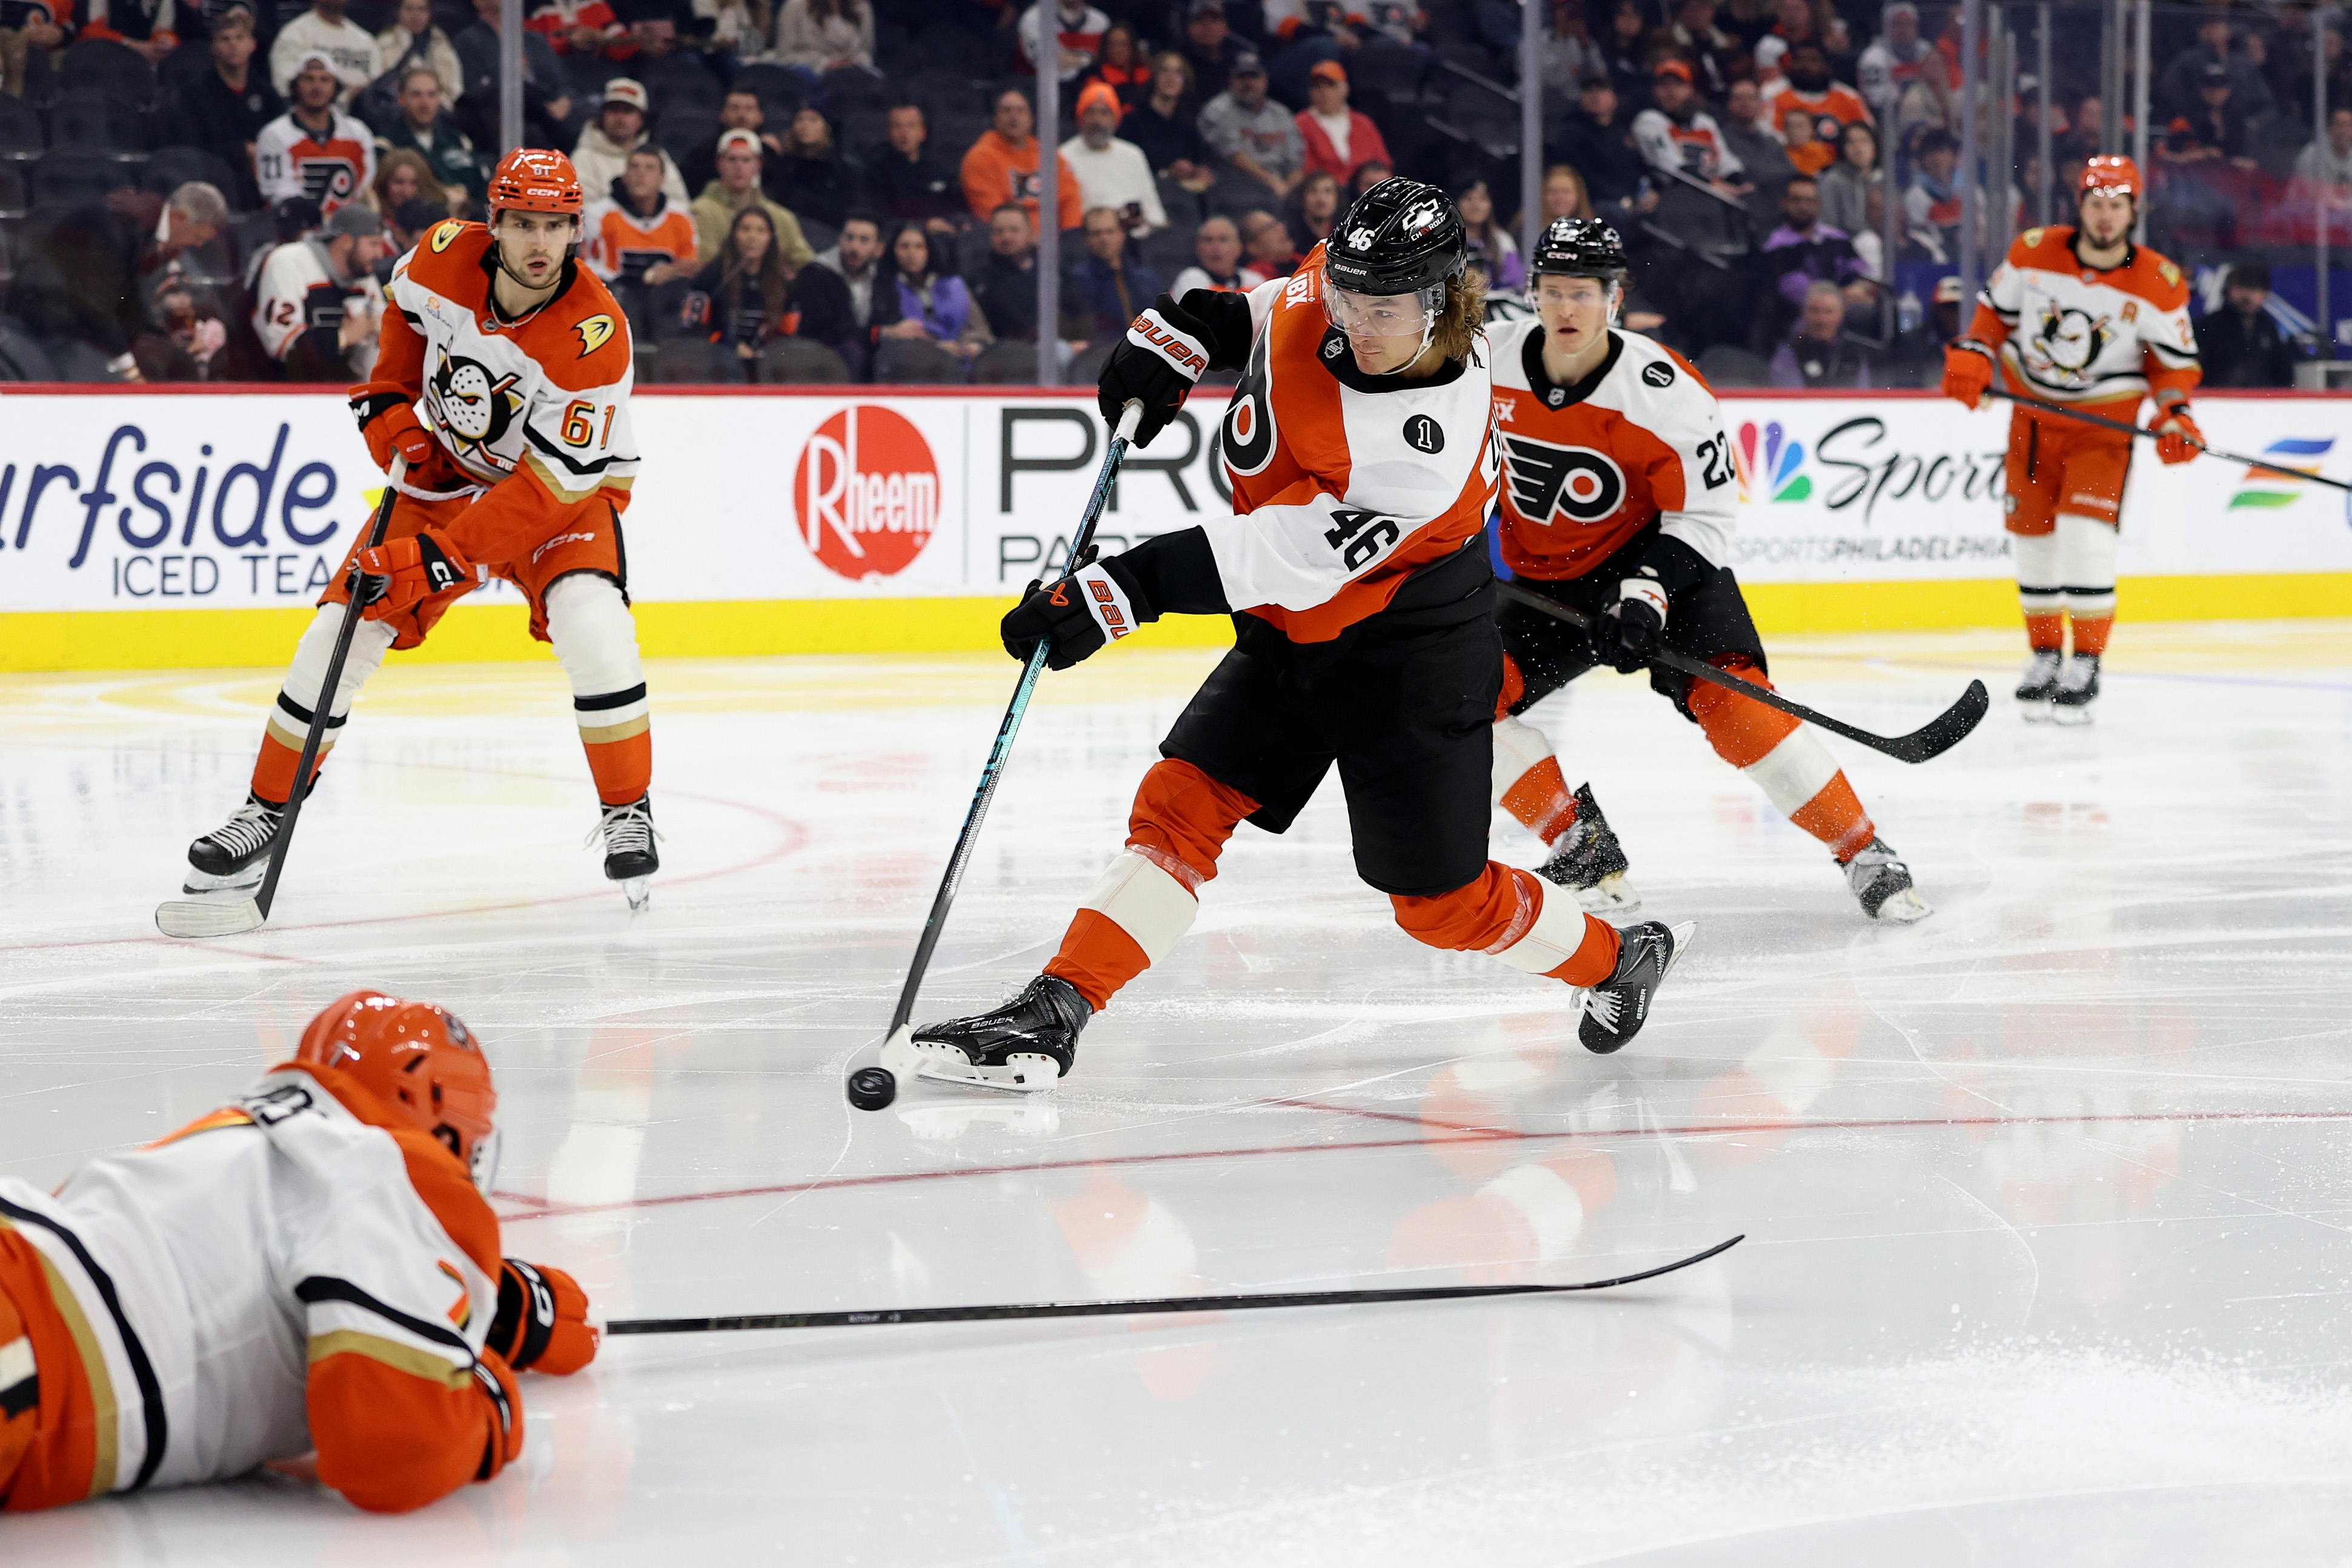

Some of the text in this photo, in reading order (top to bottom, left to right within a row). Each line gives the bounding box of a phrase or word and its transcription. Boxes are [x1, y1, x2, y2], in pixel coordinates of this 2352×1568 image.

[527, 188, 560, 198] CCM
[1347, 227, 1375, 251] 46
[1411, 215, 1446, 242] CHEVROLET
[1334, 264, 1367, 276] BAUER
[1546, 251, 1578, 261] CCM
[1285, 272, 1308, 310] IBX
[1131, 314, 1206, 376] BAUER
[560, 399, 616, 450] 61
[1417, 419, 1432, 450] 1
[807, 405, 935, 558] Rheem
[533, 532, 596, 565] CCM
[1324, 510, 1400, 573] 46
[368, 548, 380, 568] CCM
[113, 554, 331, 597] ICED TEA
[1636, 988, 1647, 1020] BAUER
[971, 1015, 1014, 1029] BAUER
